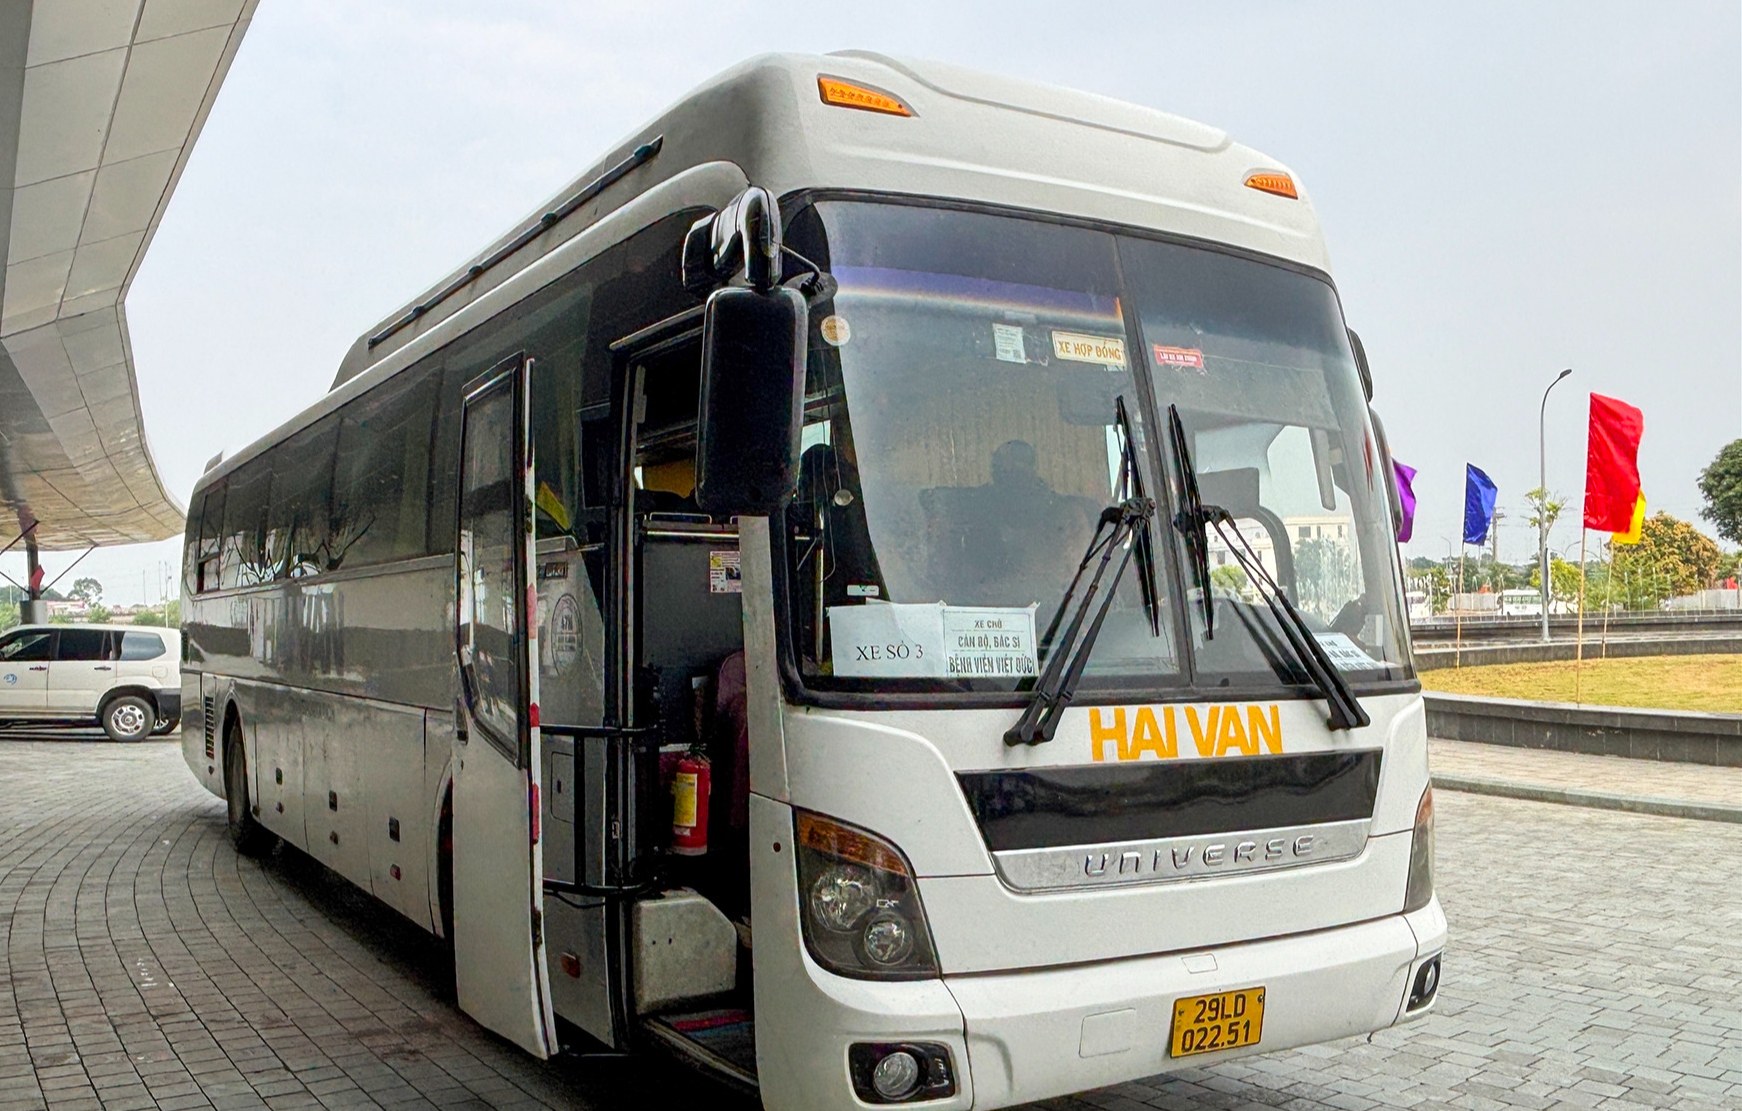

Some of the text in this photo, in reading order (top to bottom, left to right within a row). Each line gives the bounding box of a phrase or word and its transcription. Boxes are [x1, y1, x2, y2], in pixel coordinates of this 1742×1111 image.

[1058, 340, 1071, 354] XE
[974, 619, 985, 629] XE
[856, 645, 882, 661] XE
[915, 643, 924, 659] 3
[1088, 704, 1283, 762] HAI VAN
[1084, 834, 1315, 877] UNIVERSE
[1193, 993, 1247, 1025] 29LD
[1181, 1019, 1251, 1053] 022.51
